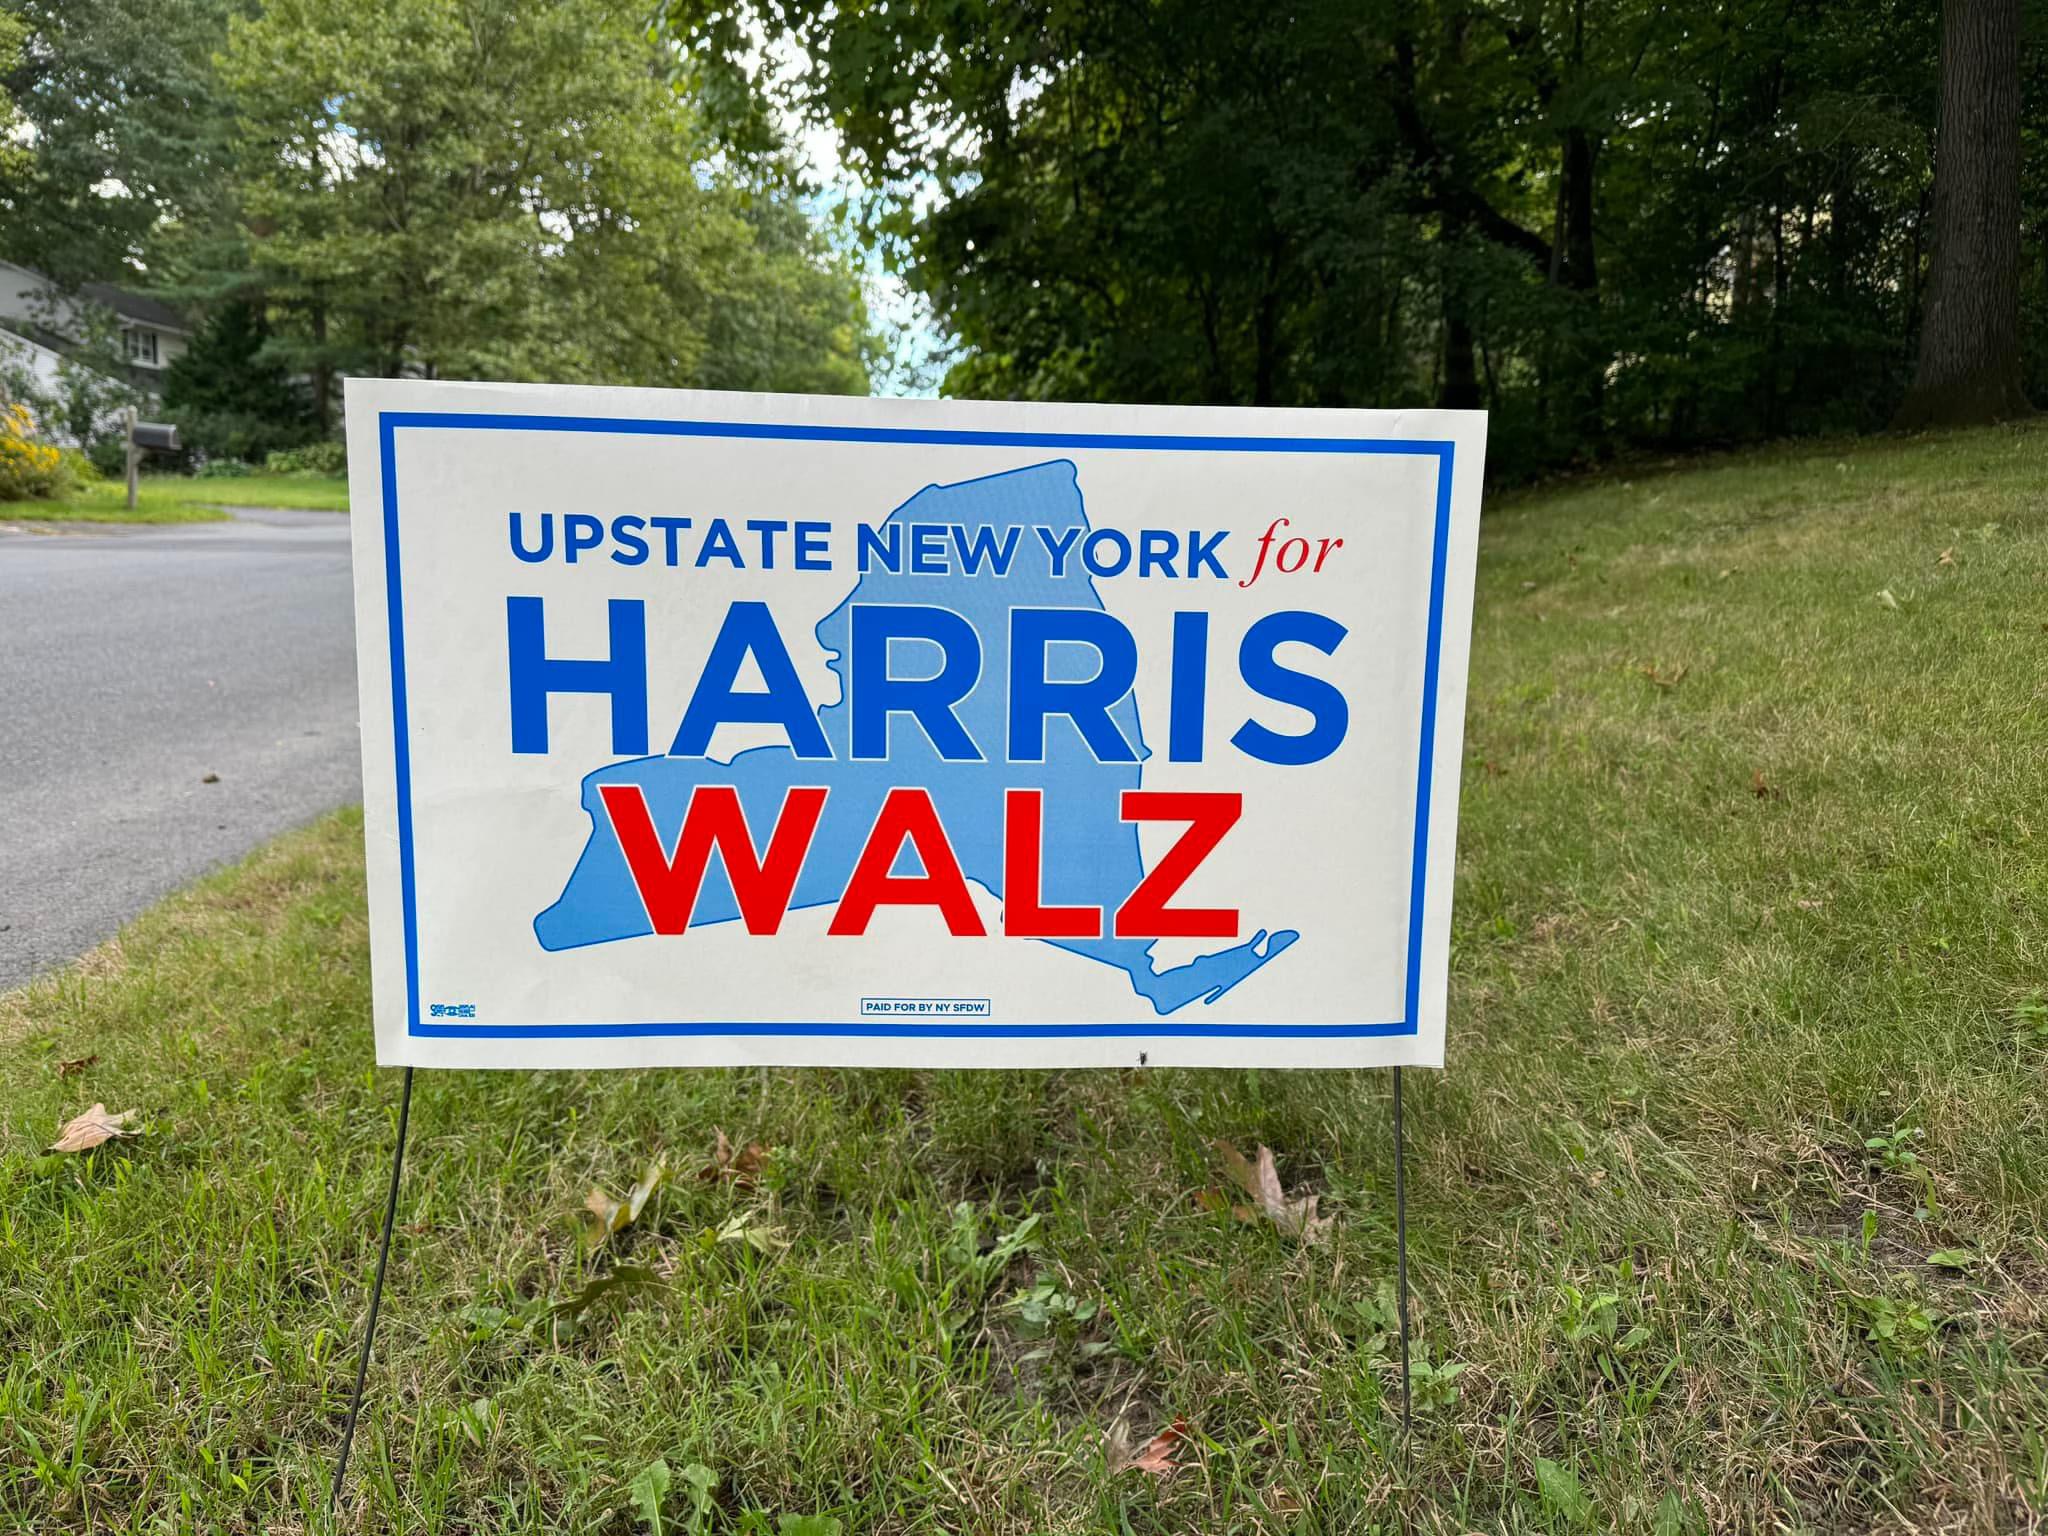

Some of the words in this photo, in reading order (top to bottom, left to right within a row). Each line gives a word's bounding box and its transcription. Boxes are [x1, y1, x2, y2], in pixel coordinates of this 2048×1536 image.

[509, 512, 832, 571] UPSTATE
[856, 522, 1021, 576] NEW
[1037, 526, 1231, 579] YORK
[1238, 517, 1344, 588] for
[507, 596, 1349, 766] HARRIS
[600, 785, 1243, 938] WALZ
[866, 1002, 892, 1012] PAID
[894, 1003, 916, 1012] FOR
[918, 1003, 933, 1012] BY
[935, 1003, 951, 1012] NY
[953, 1003, 985, 1013] SFDW
